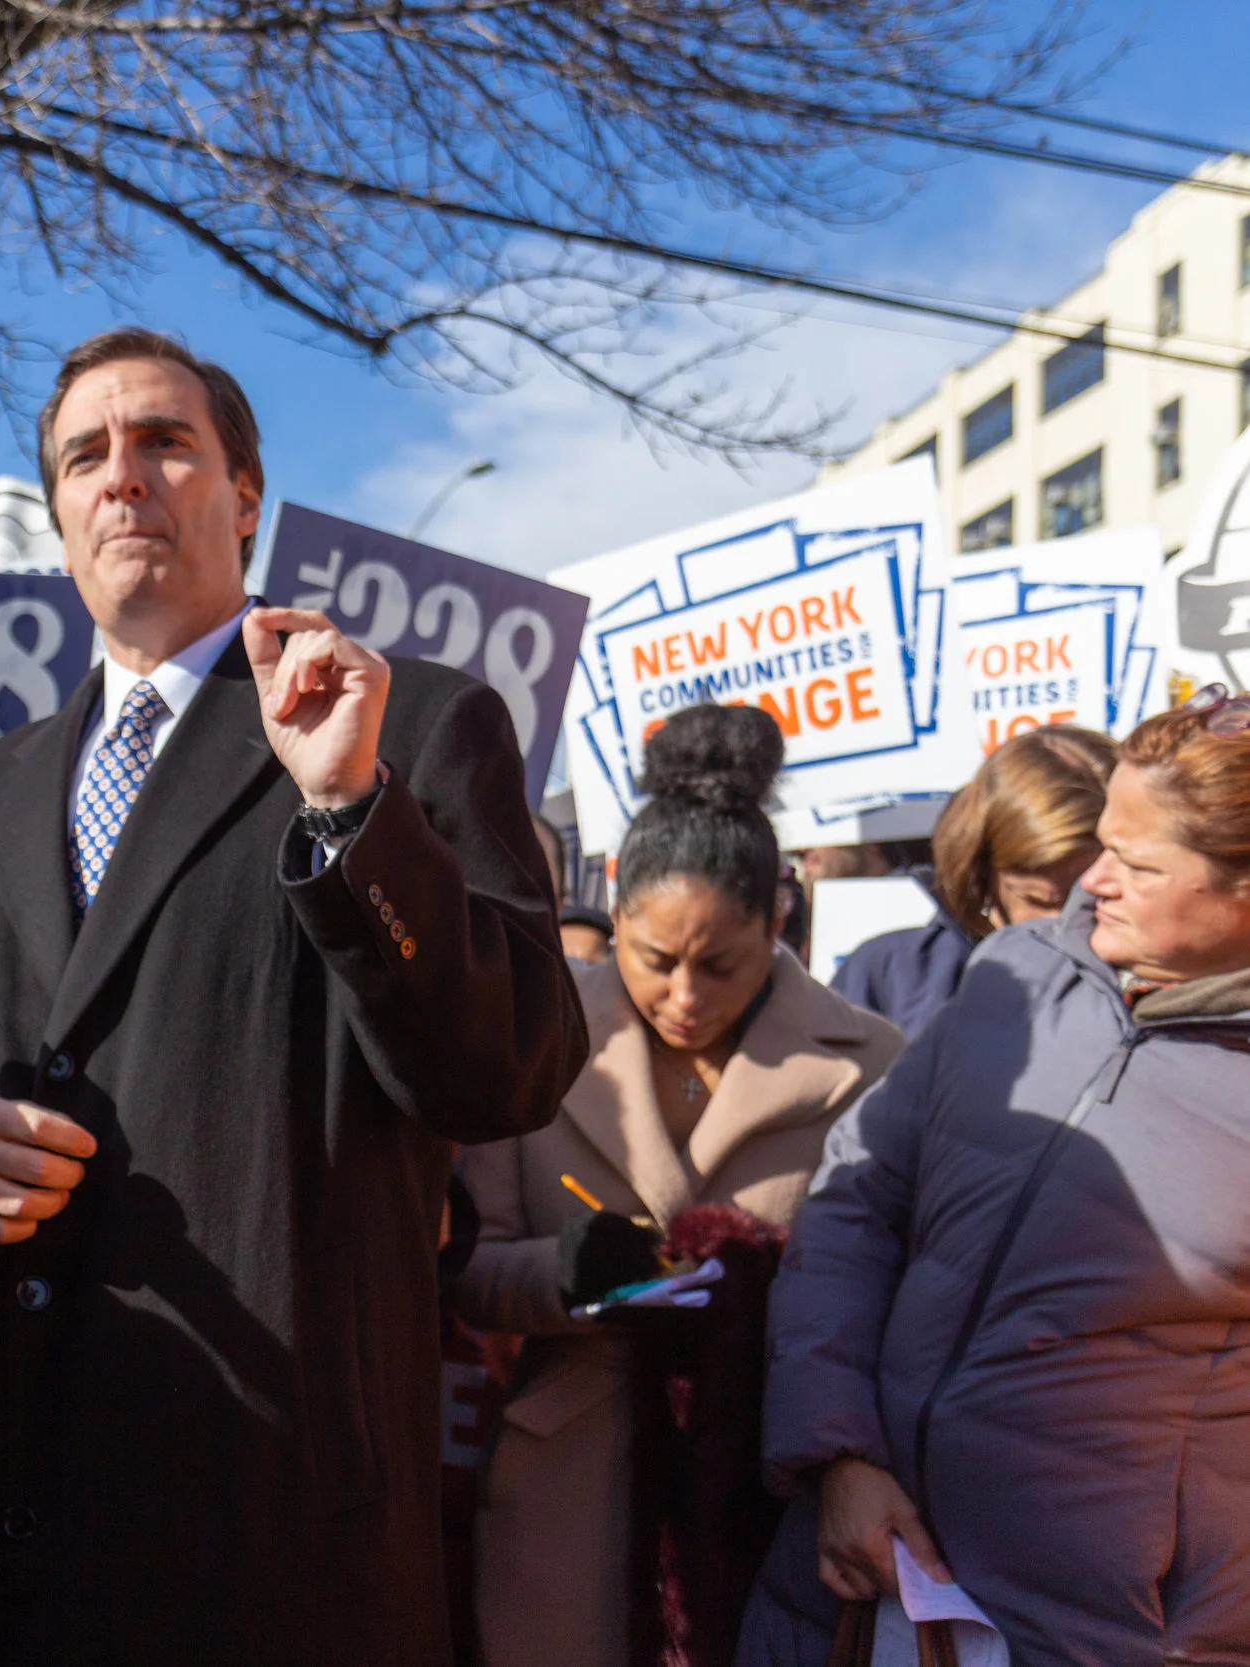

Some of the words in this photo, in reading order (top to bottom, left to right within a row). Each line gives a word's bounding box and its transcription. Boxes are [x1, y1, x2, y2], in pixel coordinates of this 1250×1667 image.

[631, 620, 728, 682] NEW
[737, 584, 863, 651] YORK
[639, 637, 855, 714] COMMUNITIES
[643, 666, 882, 742] NGE
